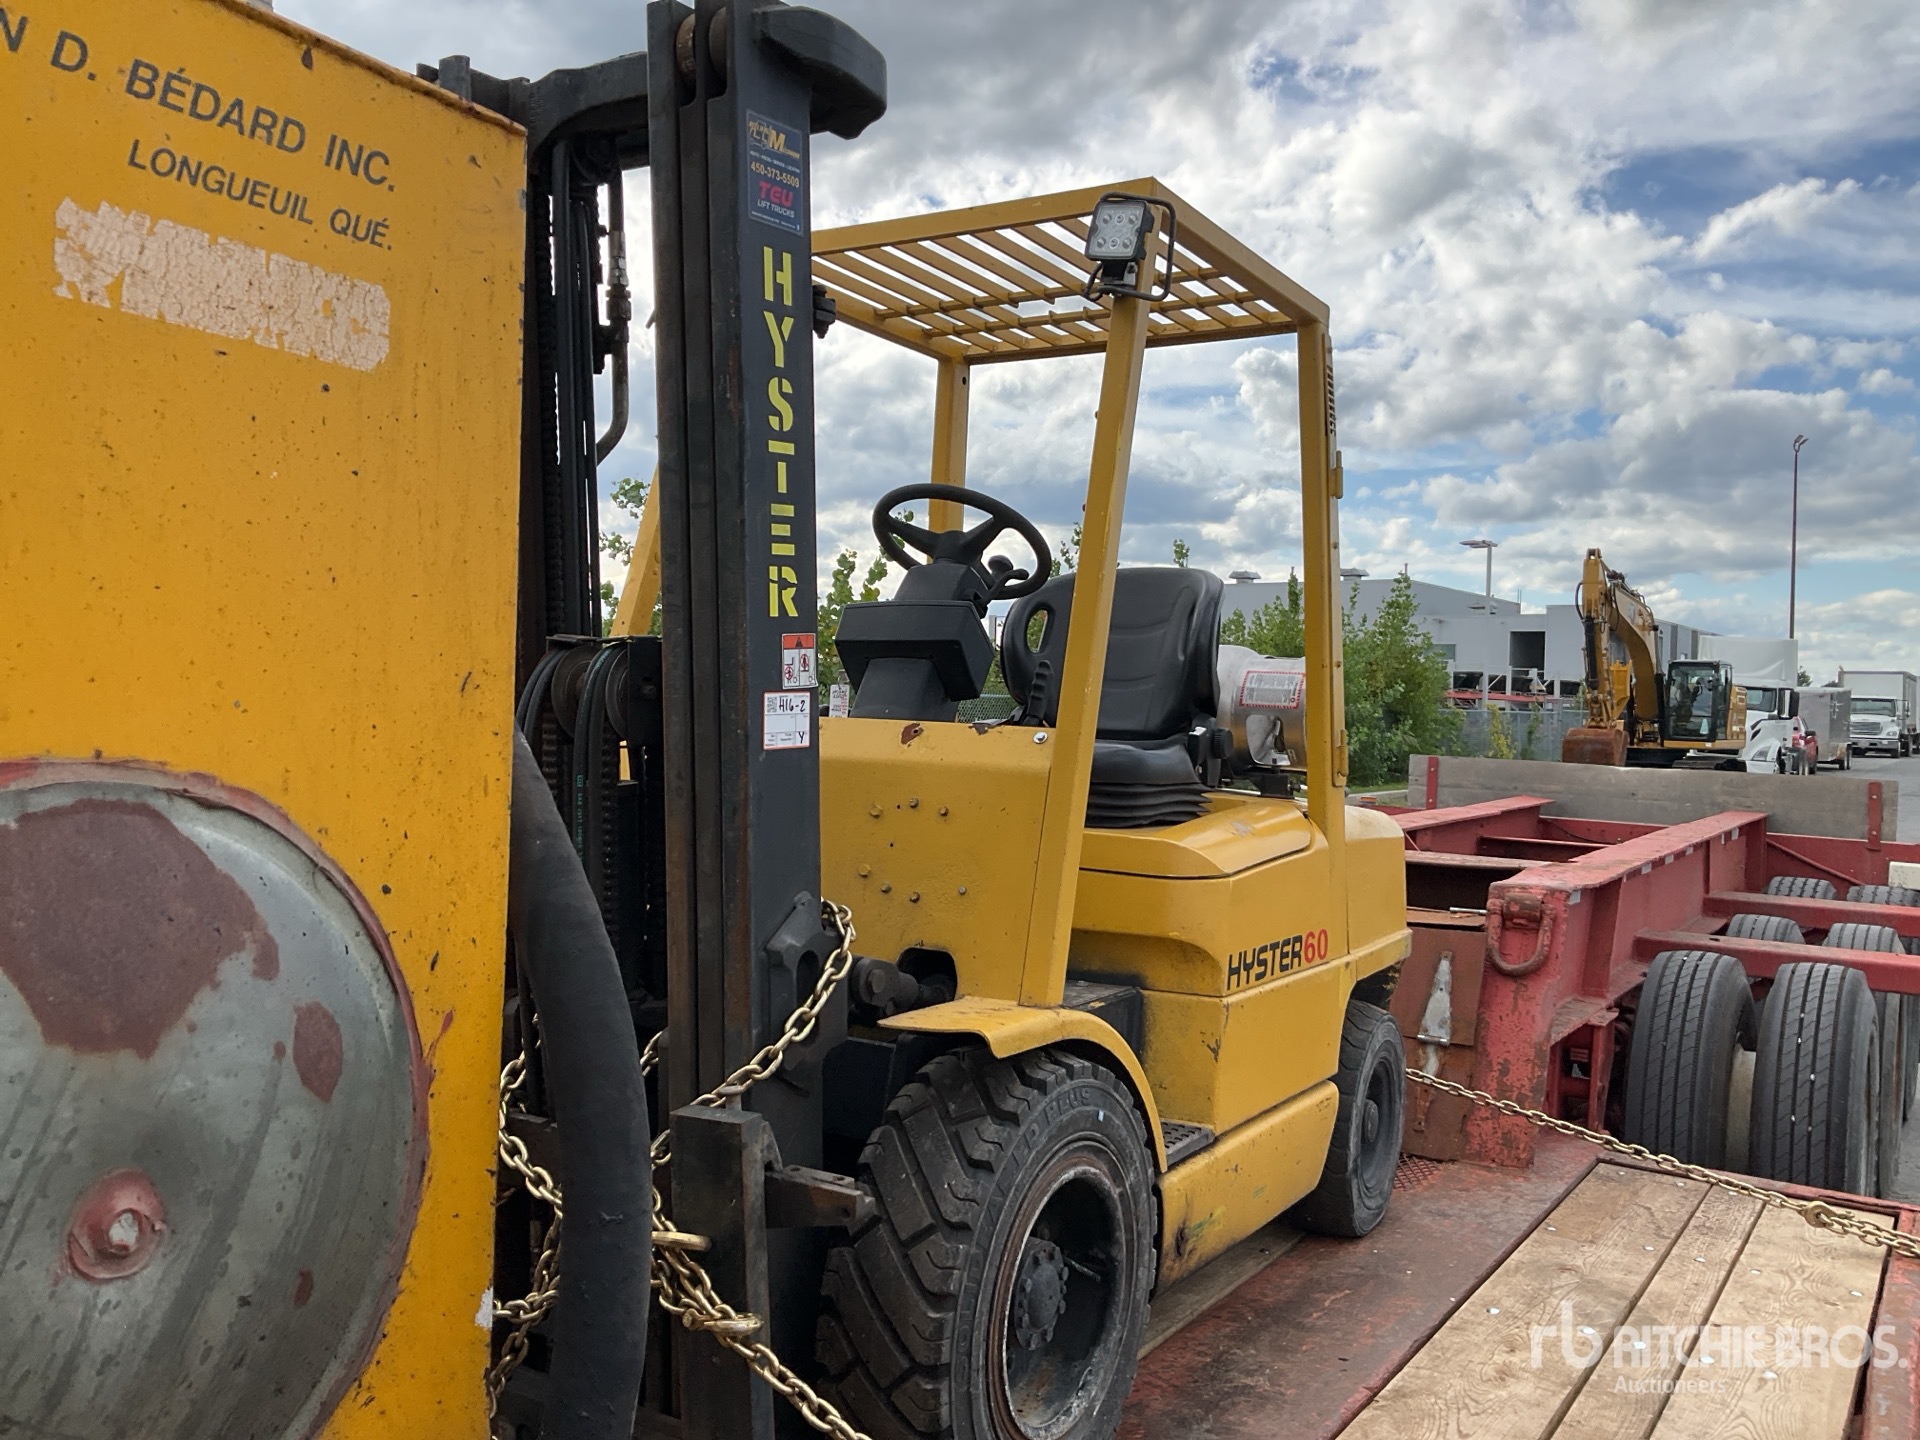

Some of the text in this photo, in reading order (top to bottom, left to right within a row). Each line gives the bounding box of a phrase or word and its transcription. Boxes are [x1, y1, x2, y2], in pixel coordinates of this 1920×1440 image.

[51, 31, 96, 80] D.
[126, 59, 306, 152] BÉDARD
[325, 135, 395, 192] INC.
[128, 139, 392, 250] LONGUEUIL QUÉ.
[757, 199, 795, 218] LIFT TRUCKS
[763, 246, 799, 617] HYSTER
[1227, 929, 1328, 990] HYSTER 60
